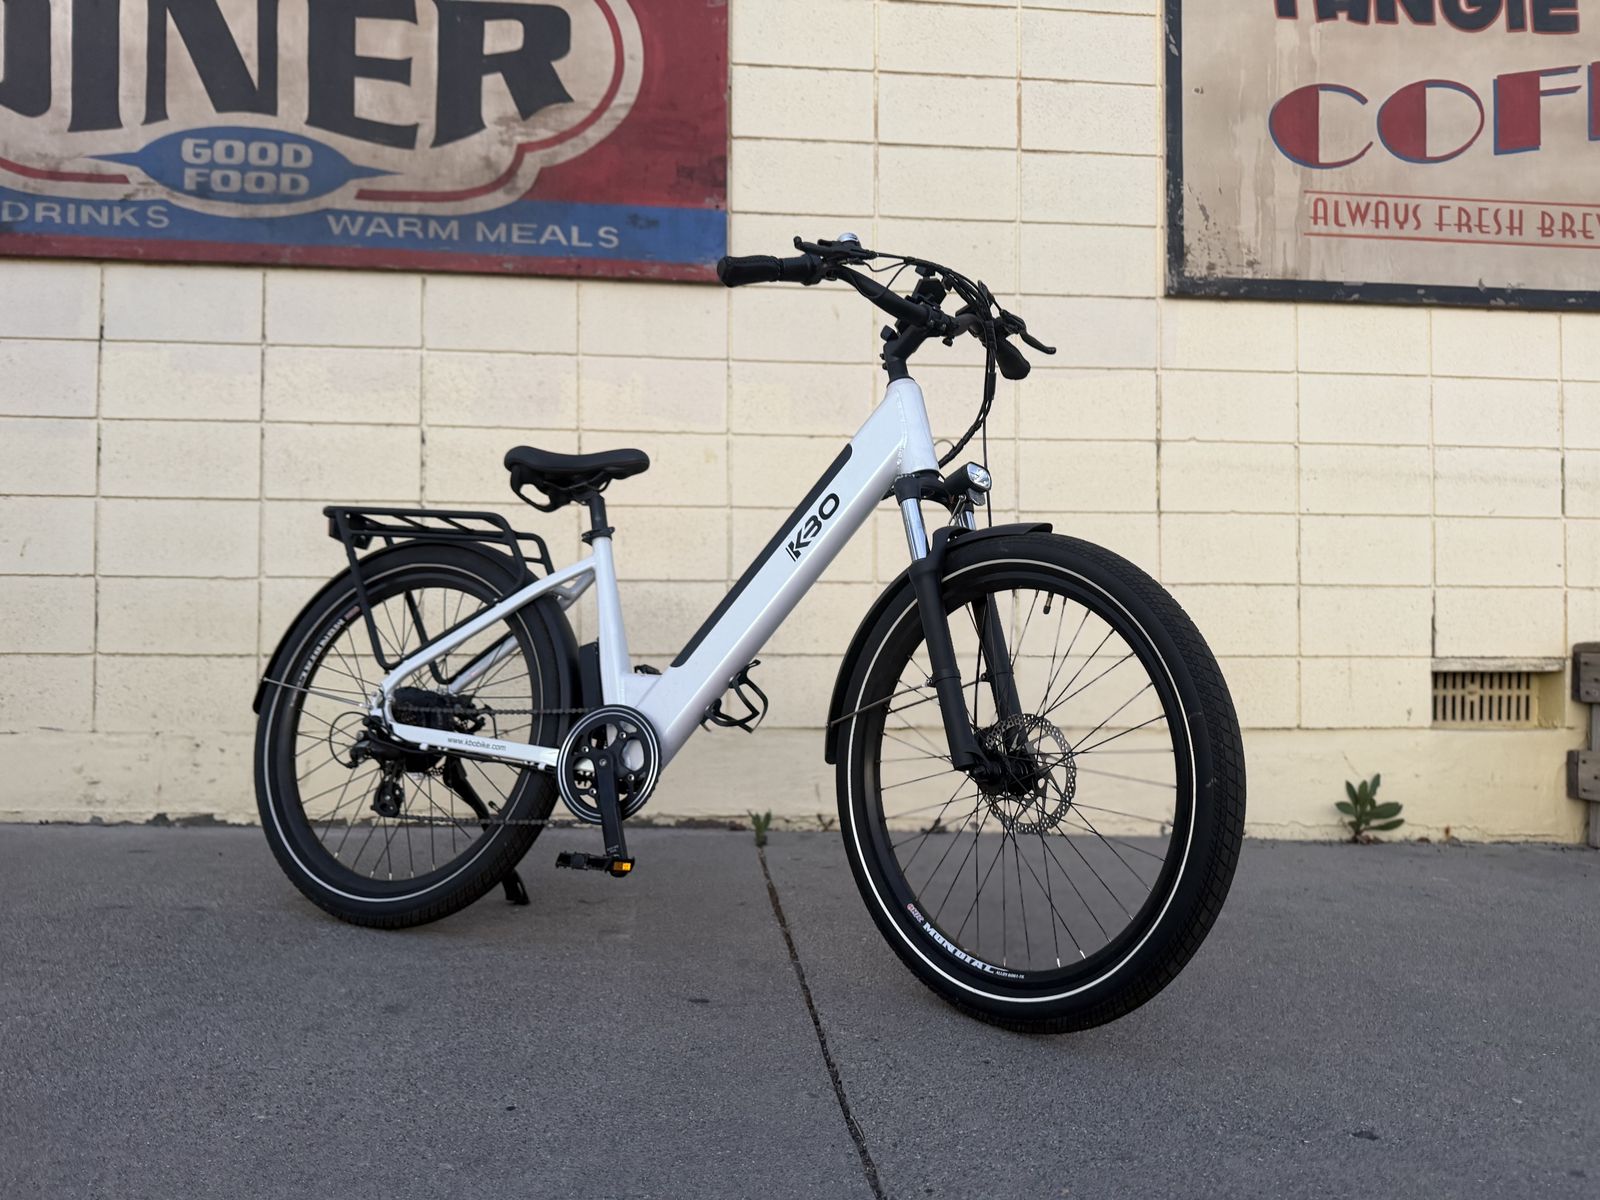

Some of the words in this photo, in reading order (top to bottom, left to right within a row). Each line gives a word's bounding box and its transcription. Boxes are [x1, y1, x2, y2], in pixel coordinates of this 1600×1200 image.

[1268, 61, 1600, 169] COF
[181, 138, 313, 168] GOOD
[183, 168, 310, 196] FOOD
[1, 203, 170, 229] DRINKS
[326, 213, 460, 241] WARM
[476, 220, 621, 249] MEALS
[1309, 197, 1422, 231] ALWAYS
[1434, 204, 1524, 237] FRESH
[1537, 210, 1600, 241] BRE
[447, 737, 507, 751] www.kbobike.com
